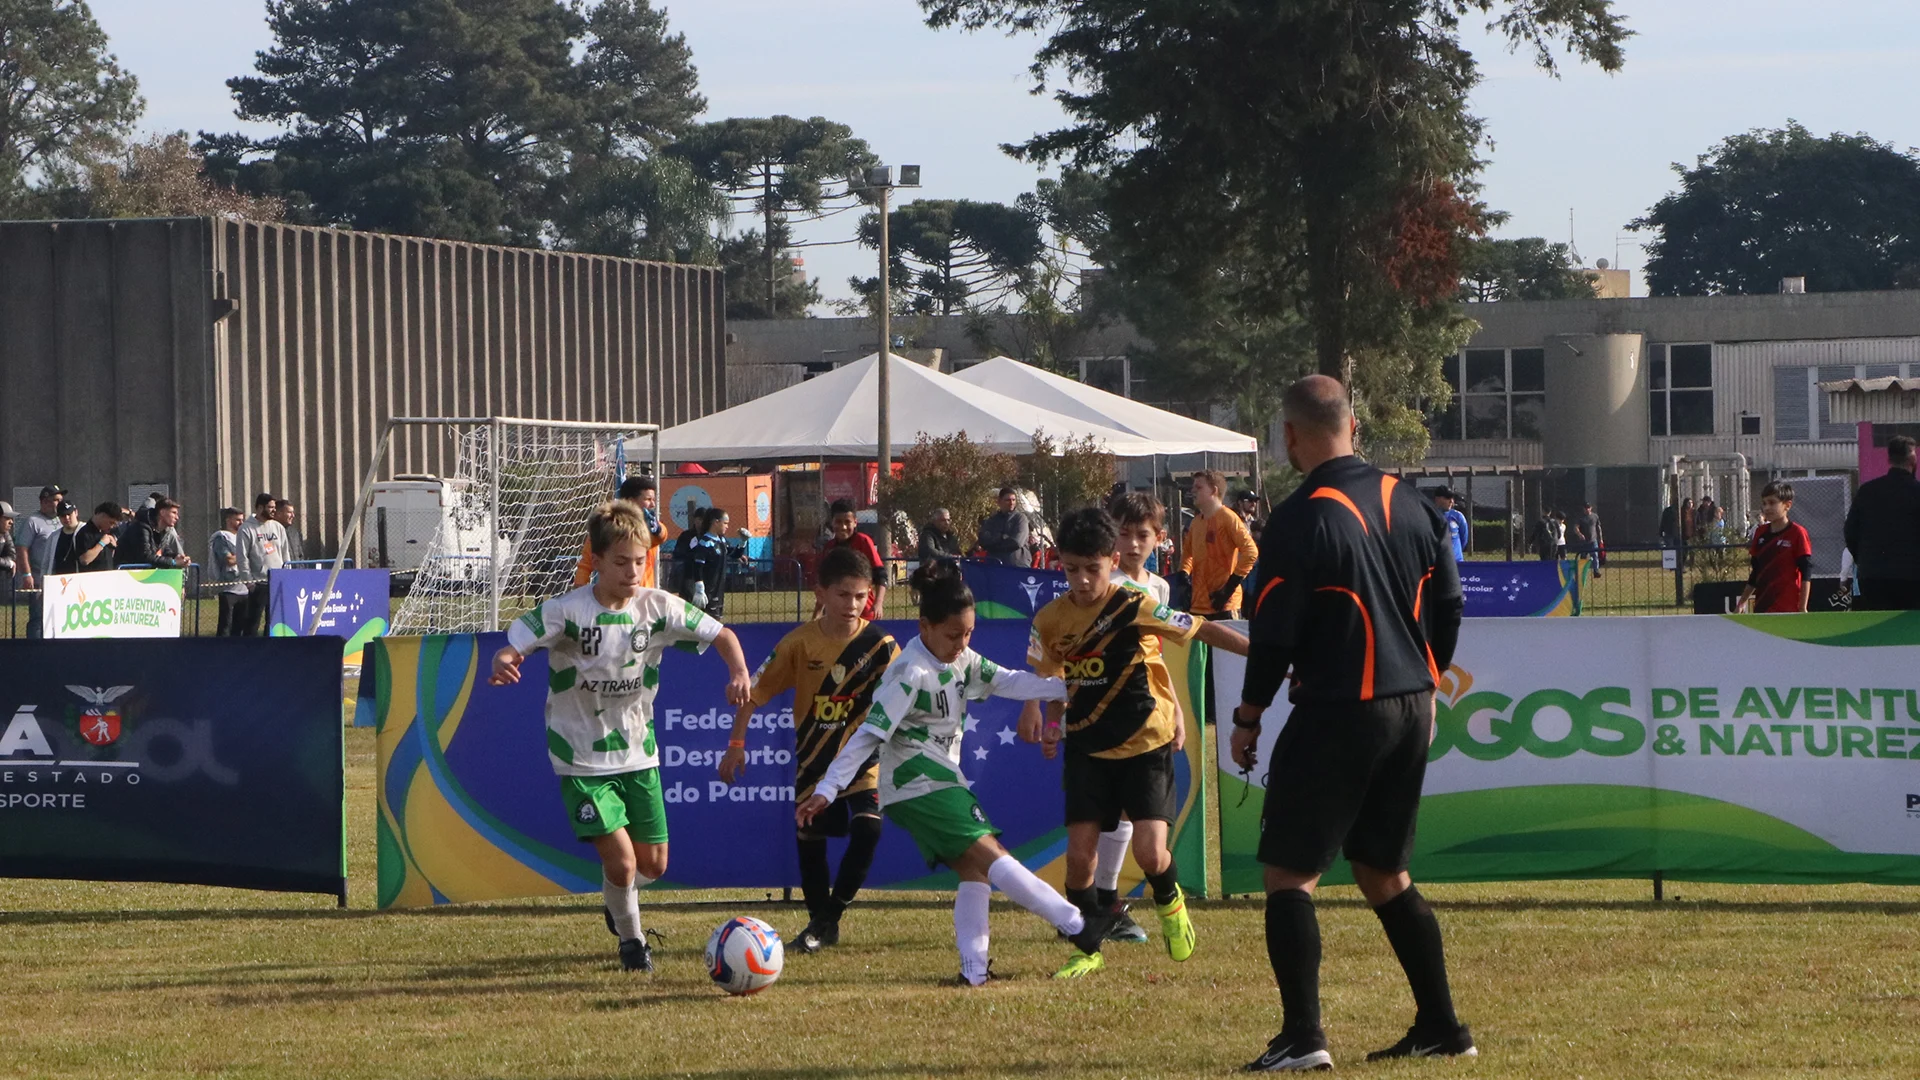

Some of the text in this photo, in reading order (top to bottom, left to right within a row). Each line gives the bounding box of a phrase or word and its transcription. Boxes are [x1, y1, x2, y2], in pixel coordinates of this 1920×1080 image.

[1462, 585, 1494, 593] Escolar
[115, 598, 167, 614] DE AVENTURA
[61, 598, 114, 633] JOGOS
[114, 612, 160, 628] & NATUREZA
[581, 627, 602, 655] 27
[580, 680, 599, 693] AZ
[1080, 677, 1108, 687] SERVICE
[1651, 687, 1720, 719] DE
[1652, 724, 1686, 755] &
[3, 771, 141, 785] ESTADO
[664, 780, 796, 803] do Paran
